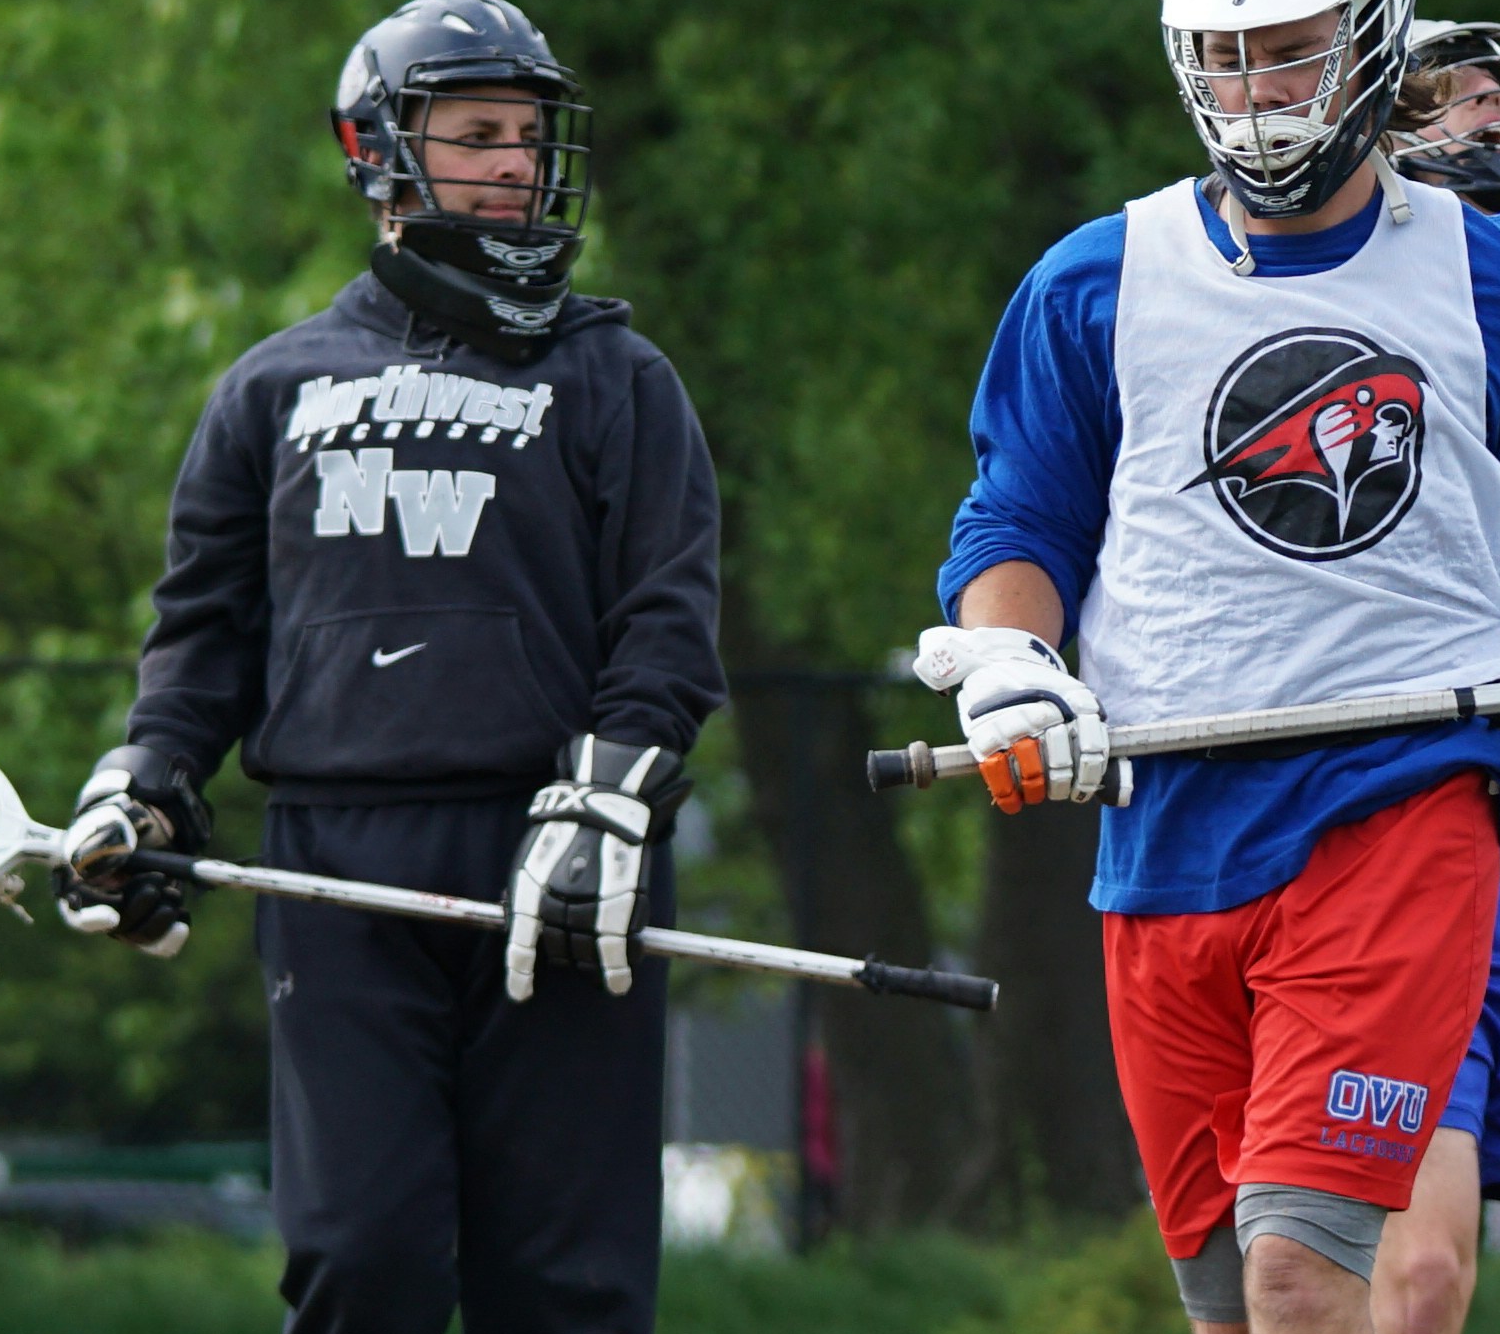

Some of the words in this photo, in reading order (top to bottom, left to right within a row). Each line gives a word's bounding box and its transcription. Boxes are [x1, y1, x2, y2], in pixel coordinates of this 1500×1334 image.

[285, 364, 553, 441] Northwest
[314, 447, 496, 558] NW
[527, 785, 596, 817] STX
[1327, 1070, 1428, 1133] OVU
